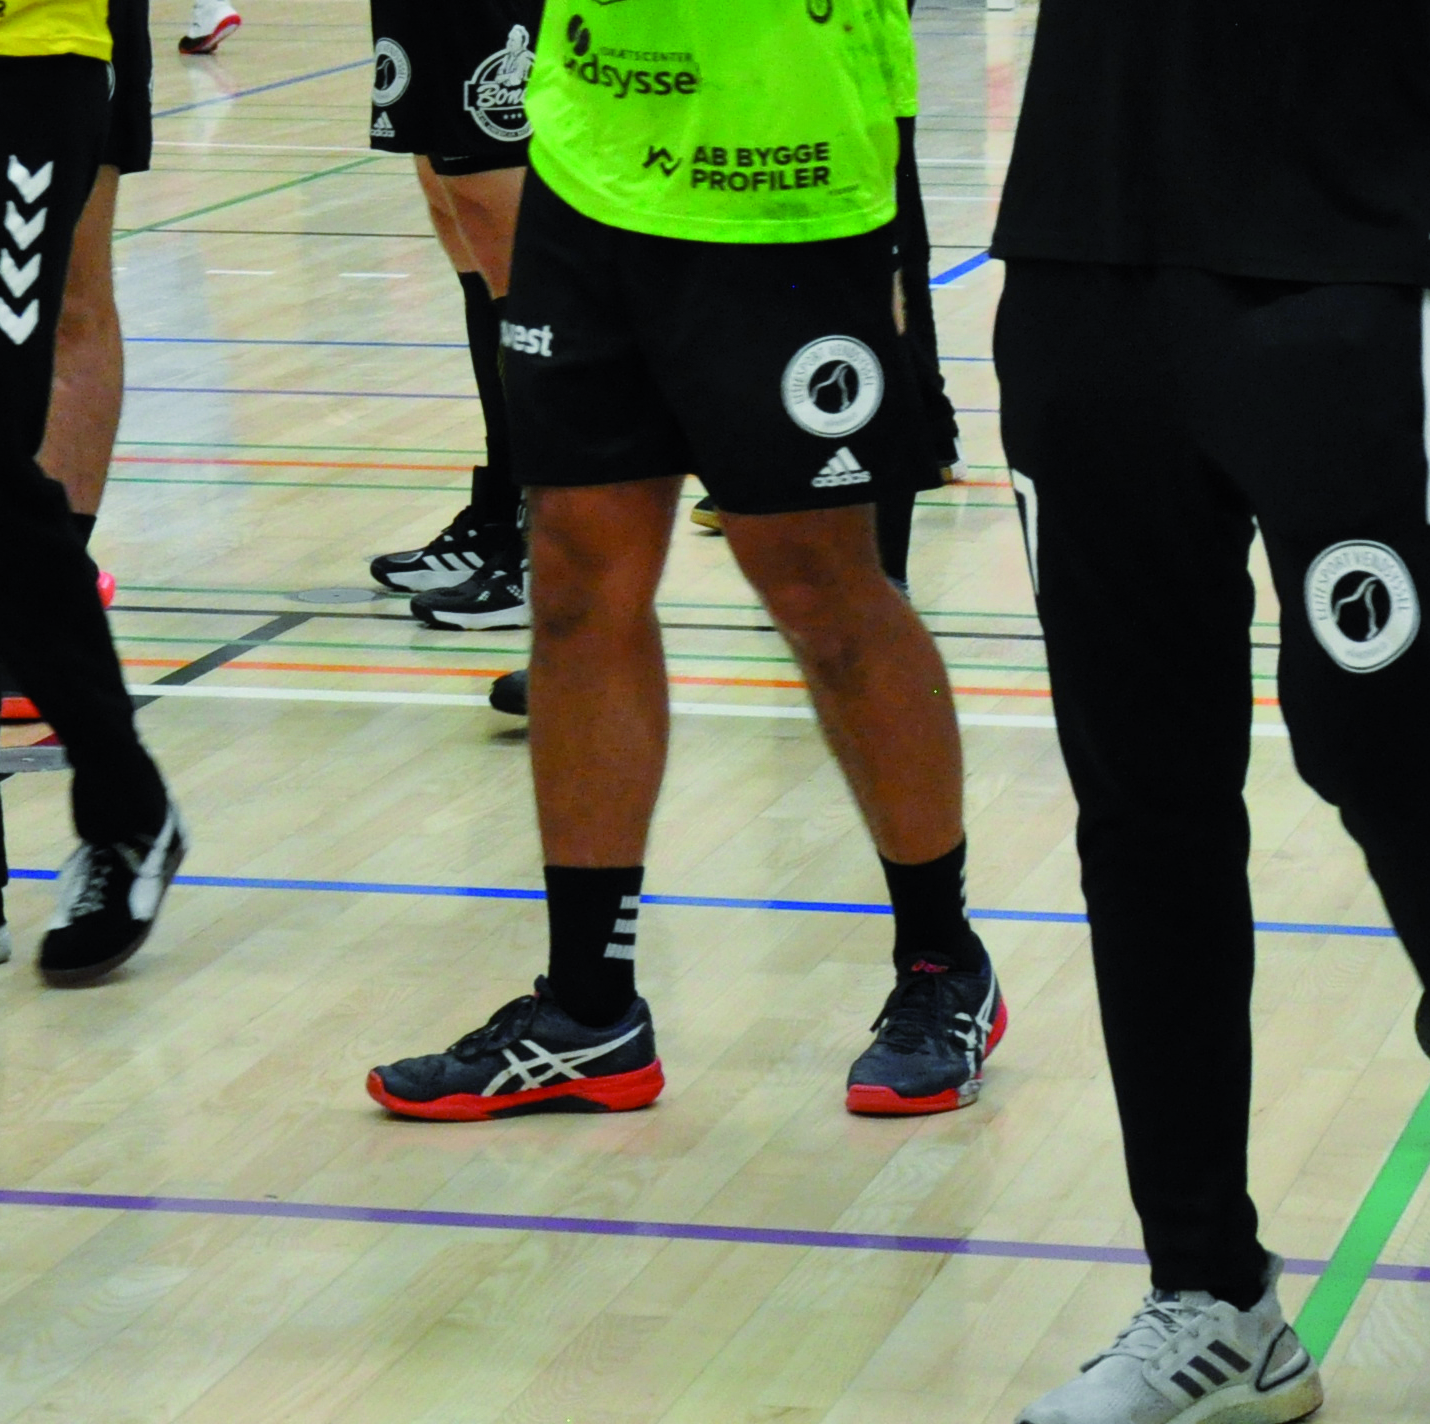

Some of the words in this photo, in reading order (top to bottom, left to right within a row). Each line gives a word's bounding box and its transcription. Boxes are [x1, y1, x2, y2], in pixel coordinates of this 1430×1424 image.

[692, 146, 725, 166] AB
[738, 141, 831, 165] BYGGE
[691, 166, 831, 193] PROFILER
